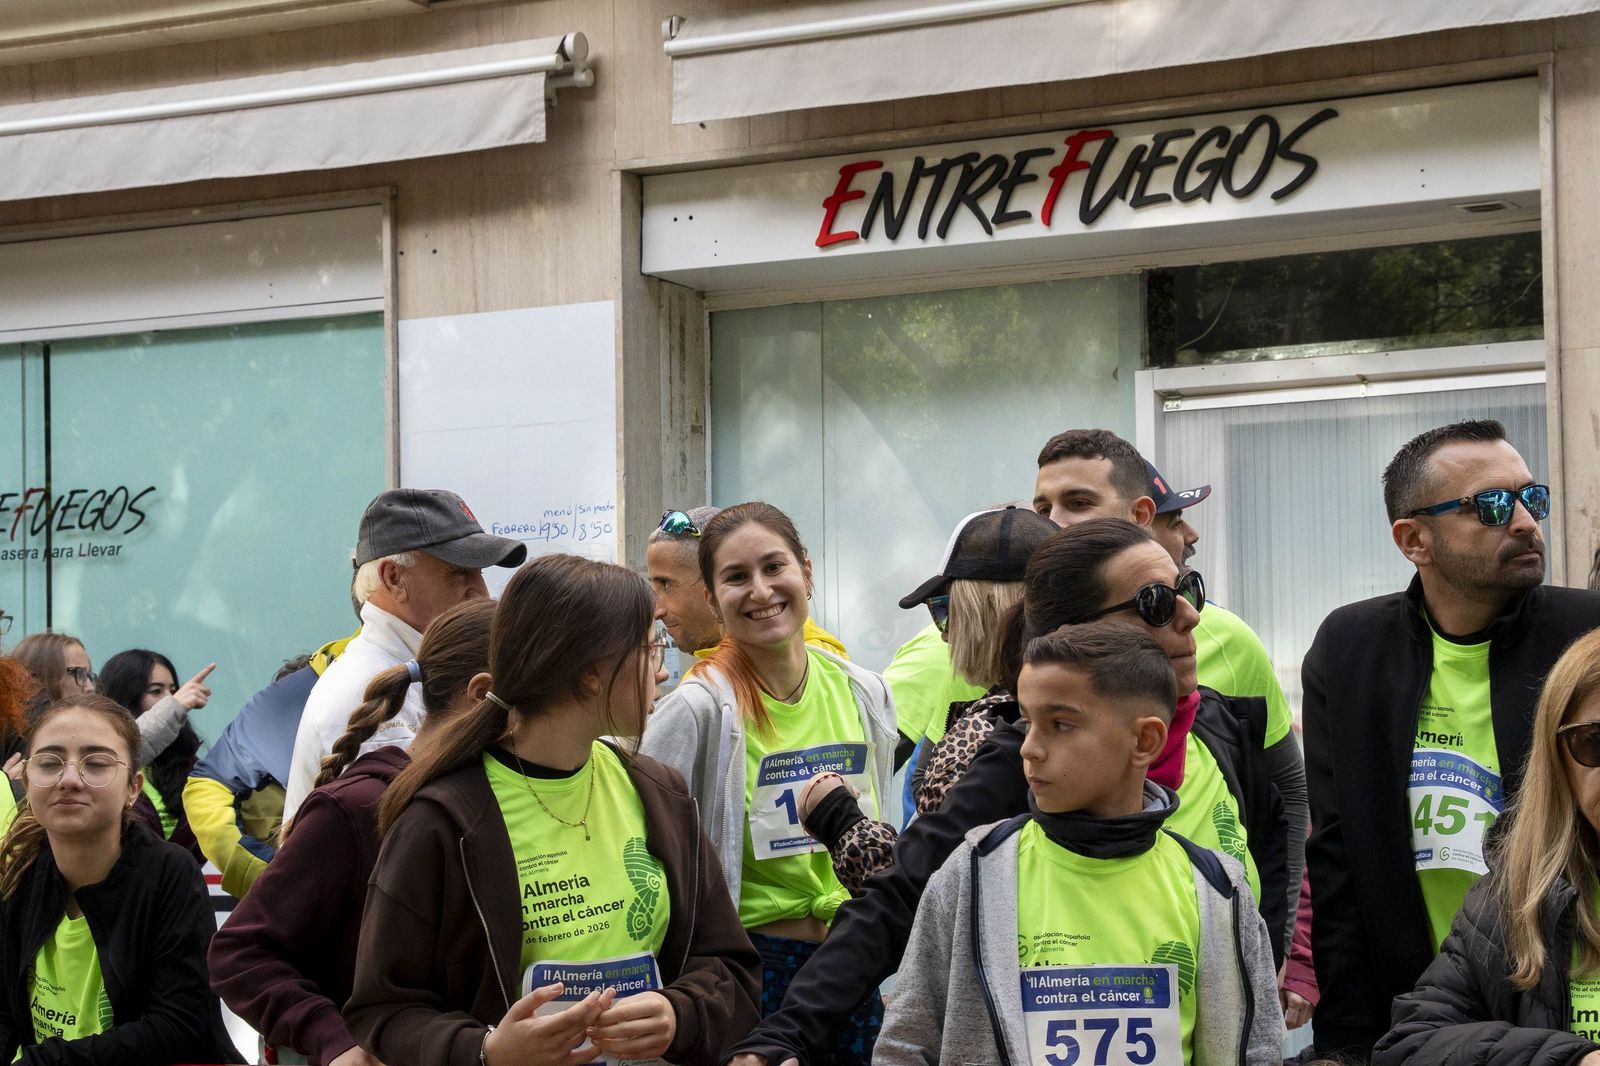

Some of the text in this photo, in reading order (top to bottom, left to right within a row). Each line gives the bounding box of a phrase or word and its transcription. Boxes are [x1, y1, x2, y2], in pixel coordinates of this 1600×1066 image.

[815, 108, 1338, 247] ENTREFUEGOS
[43, 547, 73, 562] ara
[78, 542, 122, 557] Llevar
[769, 756, 804, 767] Almería
[805, 753, 819, 762] en
[822, 747, 855, 760] marcha
[765, 769, 797, 781] contra
[798, 766, 810, 776] el
[812, 761, 844, 774] cáncer
[1427, 770, 1437, 781] el
[1440, 772, 1482, 792] cáncer
[1439, 759, 1455, 769] en
[1457, 763, 1498, 792] marcha
[524, 873, 591, 899] Almería
[532, 893, 585, 913] marcha
[521, 899, 625, 931] ontra el cáncer
[538, 931, 572, 943] febrero
[574, 928, 585, 937] de
[588, 921, 610, 933] 2026
[544, 969, 551, 980] II
[553, 969, 603, 981] Almería
[605, 968, 618, 978] en
[1030, 974, 1155, 988] II Almería en marcha
[1035, 989, 1140, 1004] contra el cáncer
[1045, 1018, 1156, 1066] 575
